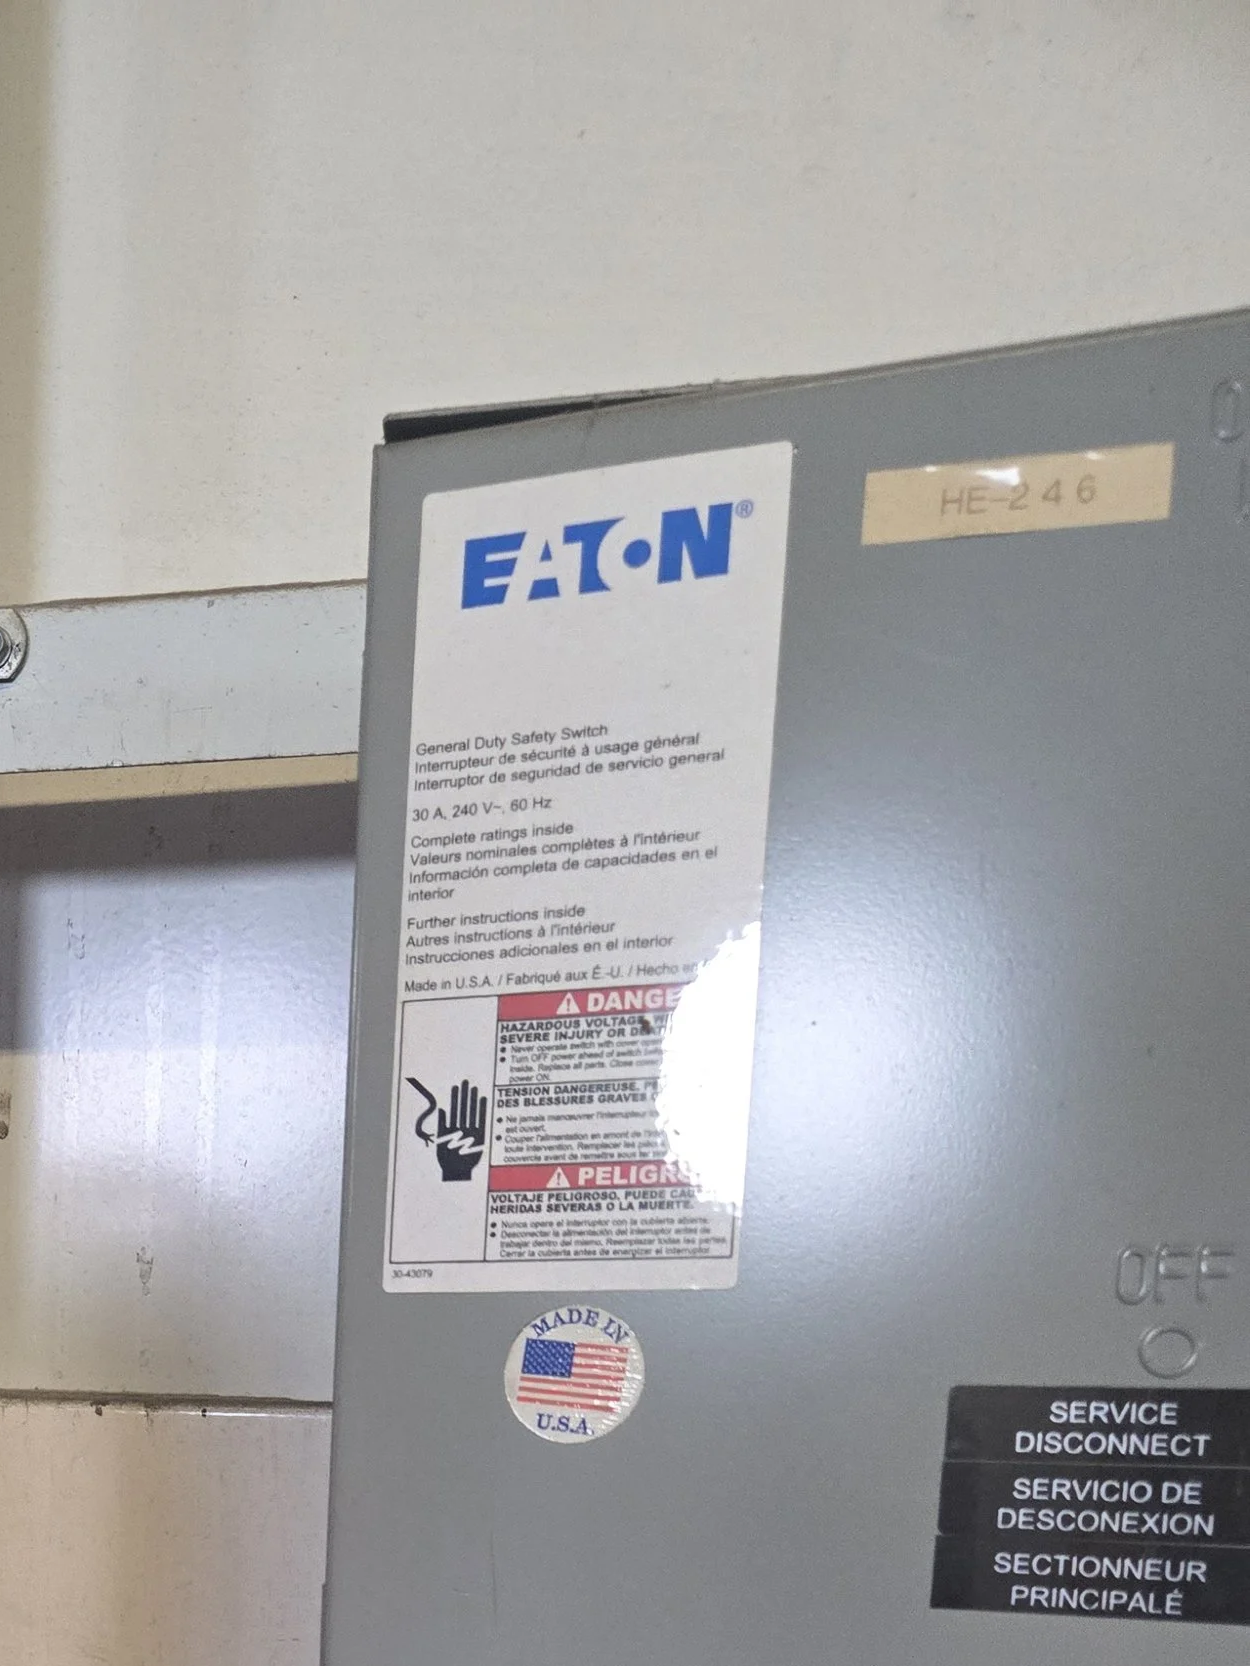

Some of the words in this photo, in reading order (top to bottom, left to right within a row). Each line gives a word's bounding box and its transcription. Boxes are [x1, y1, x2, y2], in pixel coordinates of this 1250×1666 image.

[461, 503, 734, 610] EATON
[415, 755, 494, 774] Interrupteur
[498, 752, 516, 765] de
[520, 743, 576, 763] sécurité
[582, 743, 589, 756] à
[595, 740, 639, 755] usage
[644, 732, 700, 752] général
[416, 740, 470, 756] General
[474, 736, 506, 751] Duty
[512, 731, 555, 746] Safety
[561, 724, 608, 741] Switch
[414, 772, 484, 792] Interruptor
[489, 772, 506, 784] de
[511, 762, 580, 782] seguridad
[585, 760, 603, 774] de
[608, 753, 663, 772] servicio
[669, 748, 725, 769] general
[412, 809, 429, 822] 30
[452, 804, 478, 818] 240
[510, 799, 528, 812] 60
[533, 797, 551, 810] Hz
[410, 850, 461, 866] Valeurs
[466, 845, 537, 861] nominales
[542, 835, 615, 854] complètes
[620, 835, 628, 848] à
[634, 829, 700, 846] l'intérieur
[411, 831, 476, 850] Complete
[480, 827, 527, 845] ratings
[532, 822, 574, 837] inside
[409, 867, 489, 884] Información
[494, 859, 557, 878] completa
[562, 857, 579, 871] de
[584, 850, 676, 871] capacidades
[682, 850, 700, 861] en
[705, 847, 718, 859] el
[408, 887, 454, 902] interior
[407, 914, 456, 929] Further
[460, 909, 538, 925] instructions
[543, 904, 585, 919] inside
[406, 933, 449, 948] Autres
[454, 928, 532, 945] instructions
[537, 926, 545, 938] à
[551, 921, 615, 937] l'intérieur
[405, 949, 495, 966] Instrucciones
[499, 941, 578, 958] adicionales
[583, 941, 601, 953] en
[606, 939, 618, 951] el
[623, 935, 673, 949] interior
[404, 979, 437, 993] Made
[441, 980, 451, 990] in
[455, 973, 494, 988] U.S.A.
[506, 969, 561, 988] Fabriqué
[565, 969, 588, 981] aux
[637, 962, 679, 977] Hecho
[587, 989, 682, 1012] DANGE
[500, 1020, 581, 1033] HAZARDOUS
[500, 1032, 550, 1044] SEVERE
[555, 1029, 603, 1040] INJURY
[607, 1029, 626, 1038] OR
[497, 1087, 550, 1097] TENSION
[497, 1097, 519, 1108] DES
[523, 1095, 594, 1107] BLESSURES
[598, 1093, 646, 1103] GRAVES
[490, 1204, 542, 1214] HERIDAS
[546, 1201, 602, 1212] SEVERAS
[607, 1201, 615, 1211] O
[619, 1201, 634, 1210] LA
[491, 1193, 544, 1203] VOLTAJE
[625, 1190, 666, 1200] PUEDE
[1116, 1245, 1236, 1306] OFF
[531, 1308, 599, 1337] MADE
[601, 1317, 629, 1344] IN
[1049, 1400, 1179, 1425] SERVICE
[1015, 1431, 1211, 1457] DISCONNECT
[1012, 1478, 1152, 1503] SERVICIO
[1161, 1481, 1202, 1505] DE
[997, 1507, 1214, 1536] DESCONEXION
[993, 1552, 1207, 1583] SECTIONNEUR
